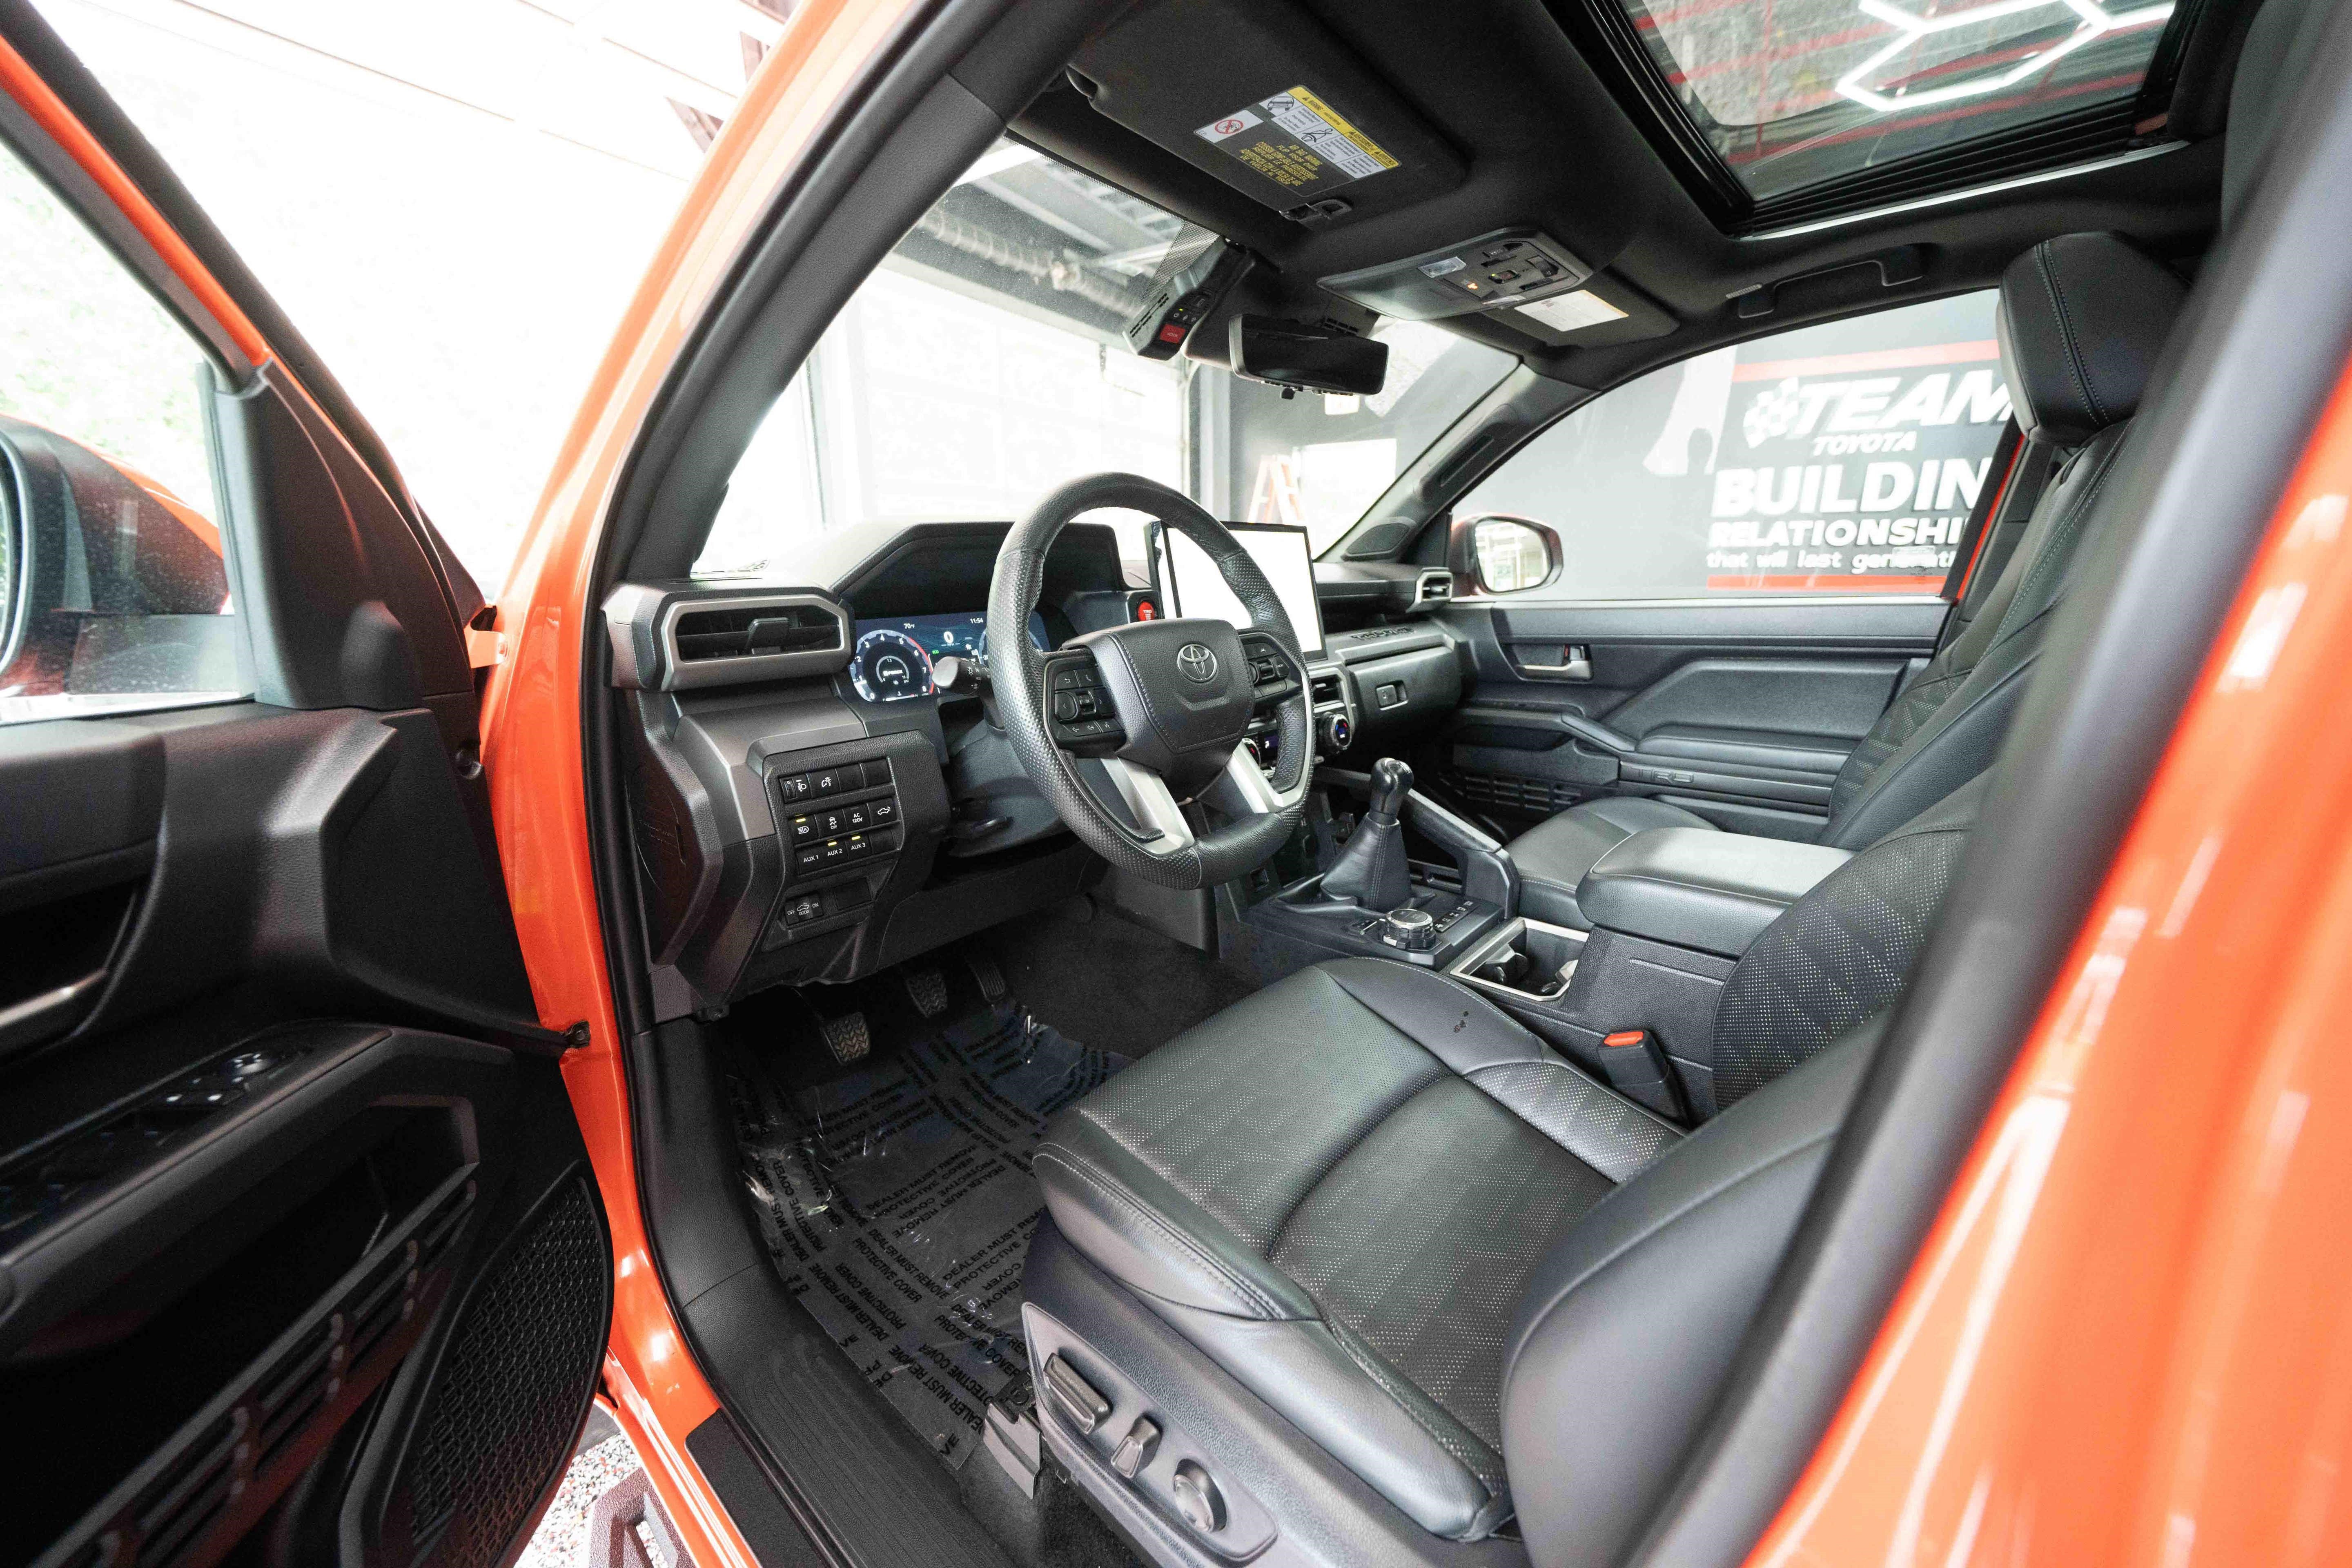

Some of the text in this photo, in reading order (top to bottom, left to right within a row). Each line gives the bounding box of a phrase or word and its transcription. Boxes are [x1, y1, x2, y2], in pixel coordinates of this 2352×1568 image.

[1788, 369, 2014, 439] TEAM
[1811, 431, 1917, 456] TOYOTA
[1711, 457, 1993, 517] BUILDIN
[1707, 517, 1968, 547] RELATIONSHI
[1707, 550, 1748, 568] that
[1756, 550, 1788, 568] will
[1797, 550, 1842, 568] last
[944, 631, 953, 644] 0
[773, 1160, 795, 1196] COVER
[865, 1186, 909, 1210] DEALER
[909, 1168, 937, 1189] MUST
[874, 1157, 975, 1218] PROTECTIVE COVER
[771, 1197, 788, 1229] MUS
[892, 1164, 1007, 1238] DEALER MUST REMOVE
[899, 1197, 935, 1219] COVER
[788, 1197, 828, 1253] PROTECTIVE
[782, 1227, 810, 1263] DEALER
[942, 1249, 988, 1281] DEALER
[987, 1227, 1018, 1250] MUST
[808, 1263, 842, 1295] REMOVE
[835, 1262, 862, 1289] COVER
[852, 1237, 923, 1303] PROTECTIVE COVER
[868, 1228, 951, 1300] DEALER MUST REMOVE
[953, 1241, 1022, 1290] PROTECTIVE
[982, 1262, 1022, 1291] COVER
[834, 1292, 862, 1314] MUST
[858, 1287, 907, 1330] PROTECTIVE
[855, 1310, 890, 1341] DEALER
[918, 1343, 951, 1369] COVER
[984, 1347, 1021, 1377] COVER
[922, 1376, 954, 1404] MUST
